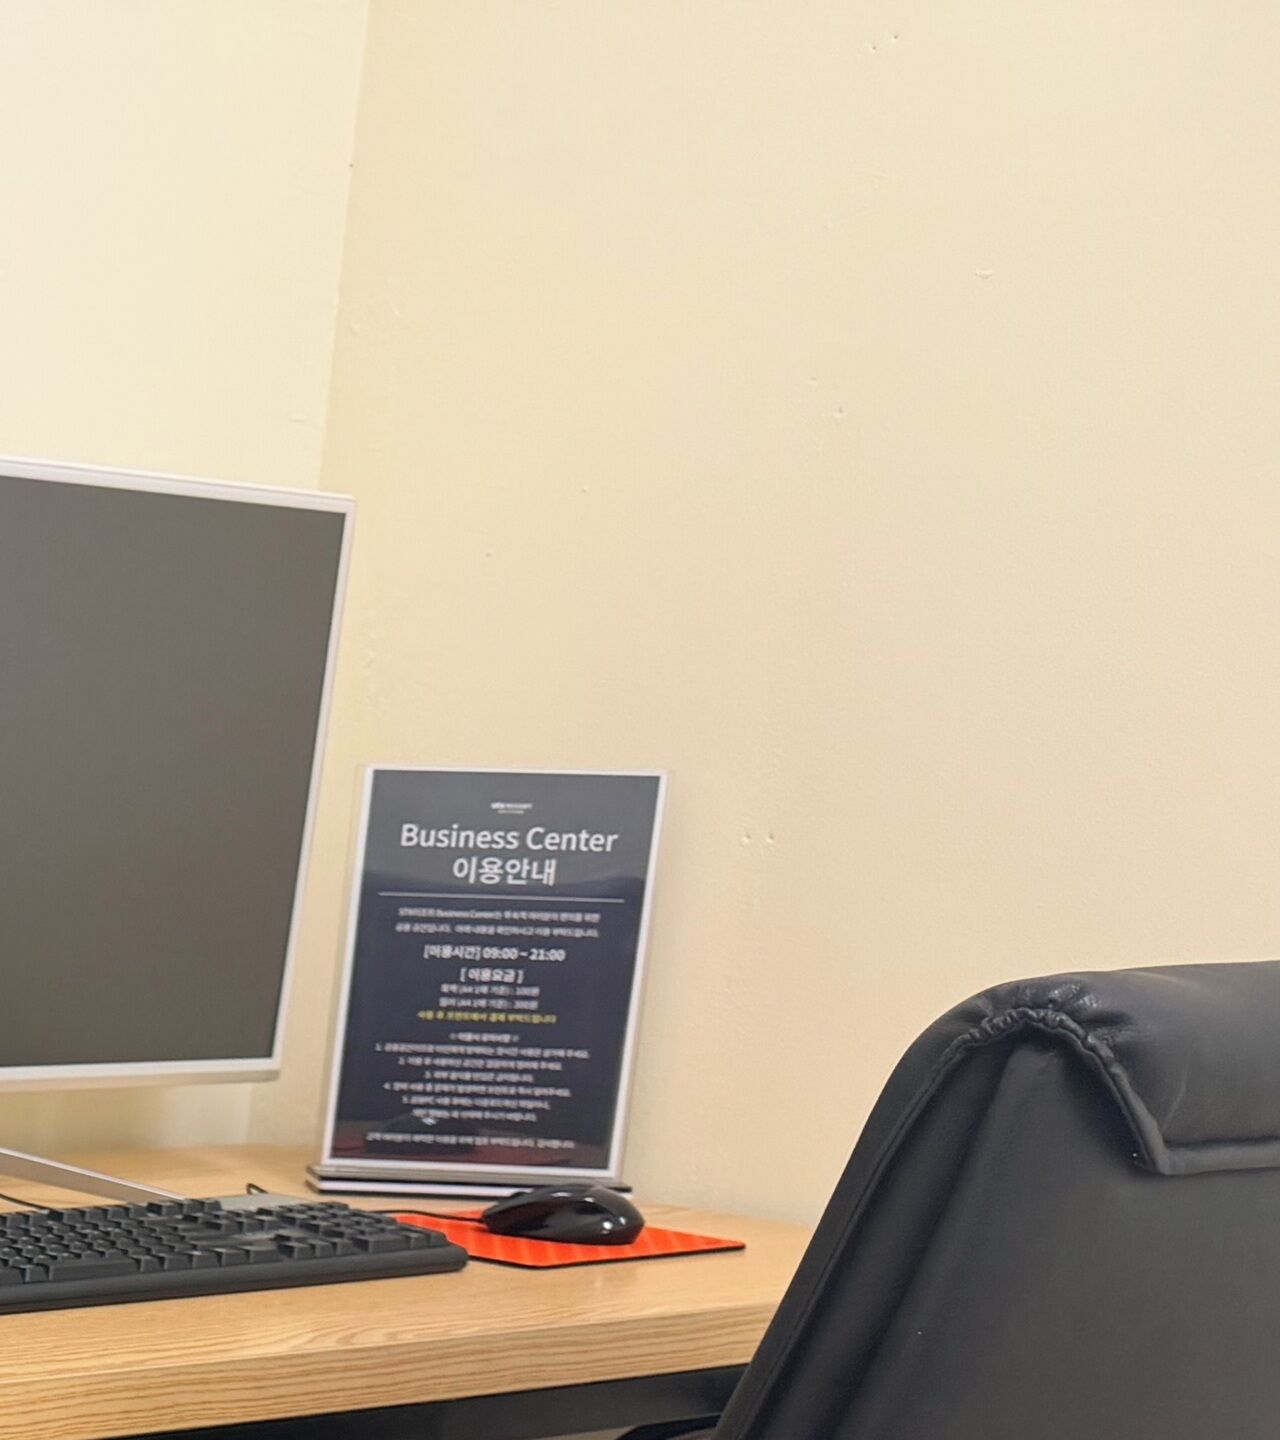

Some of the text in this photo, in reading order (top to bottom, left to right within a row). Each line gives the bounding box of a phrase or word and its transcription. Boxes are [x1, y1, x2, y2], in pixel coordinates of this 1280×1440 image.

[400, 823, 619, 852] Business Center
[452, 856, 557, 886] 이용안내
[483, 947, 518, 960] 09:00
[529, 949, 566, 961] 21:00
